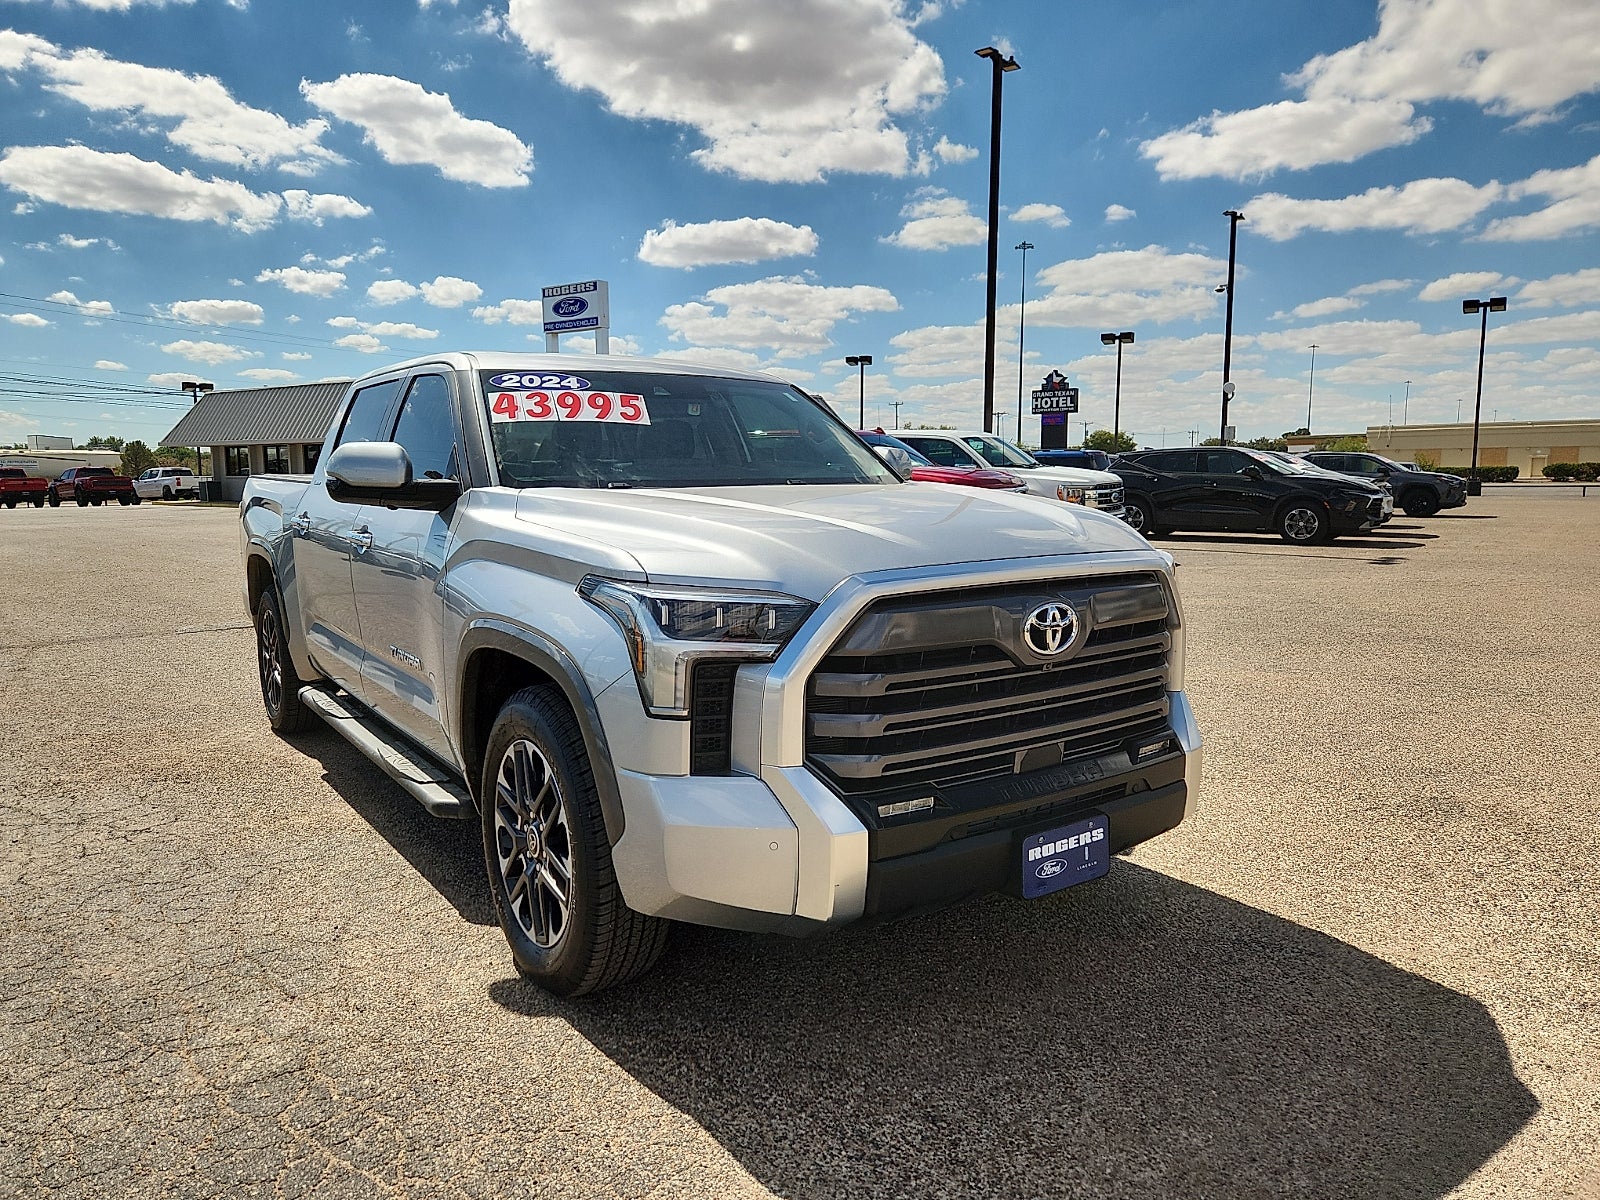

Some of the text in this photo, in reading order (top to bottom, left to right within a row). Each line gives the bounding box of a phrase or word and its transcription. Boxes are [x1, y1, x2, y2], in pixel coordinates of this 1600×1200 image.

[544, 282, 595, 297] ROGERS
[559, 300, 581, 314] Ford
[573, 318, 597, 327] VEHICLES
[501, 374, 580, 389] 2024
[492, 391, 643, 421] 43995
[1032, 396, 1075, 409] HOTEL
[390, 644, 423, 671] TUNDRA
[995, 760, 1105, 800] TUNDRA
[1028, 827, 1105, 862] ROGERS
[1041, 861, 1062, 876] Ford
[1076, 860, 1098, 871] LINCOLN
